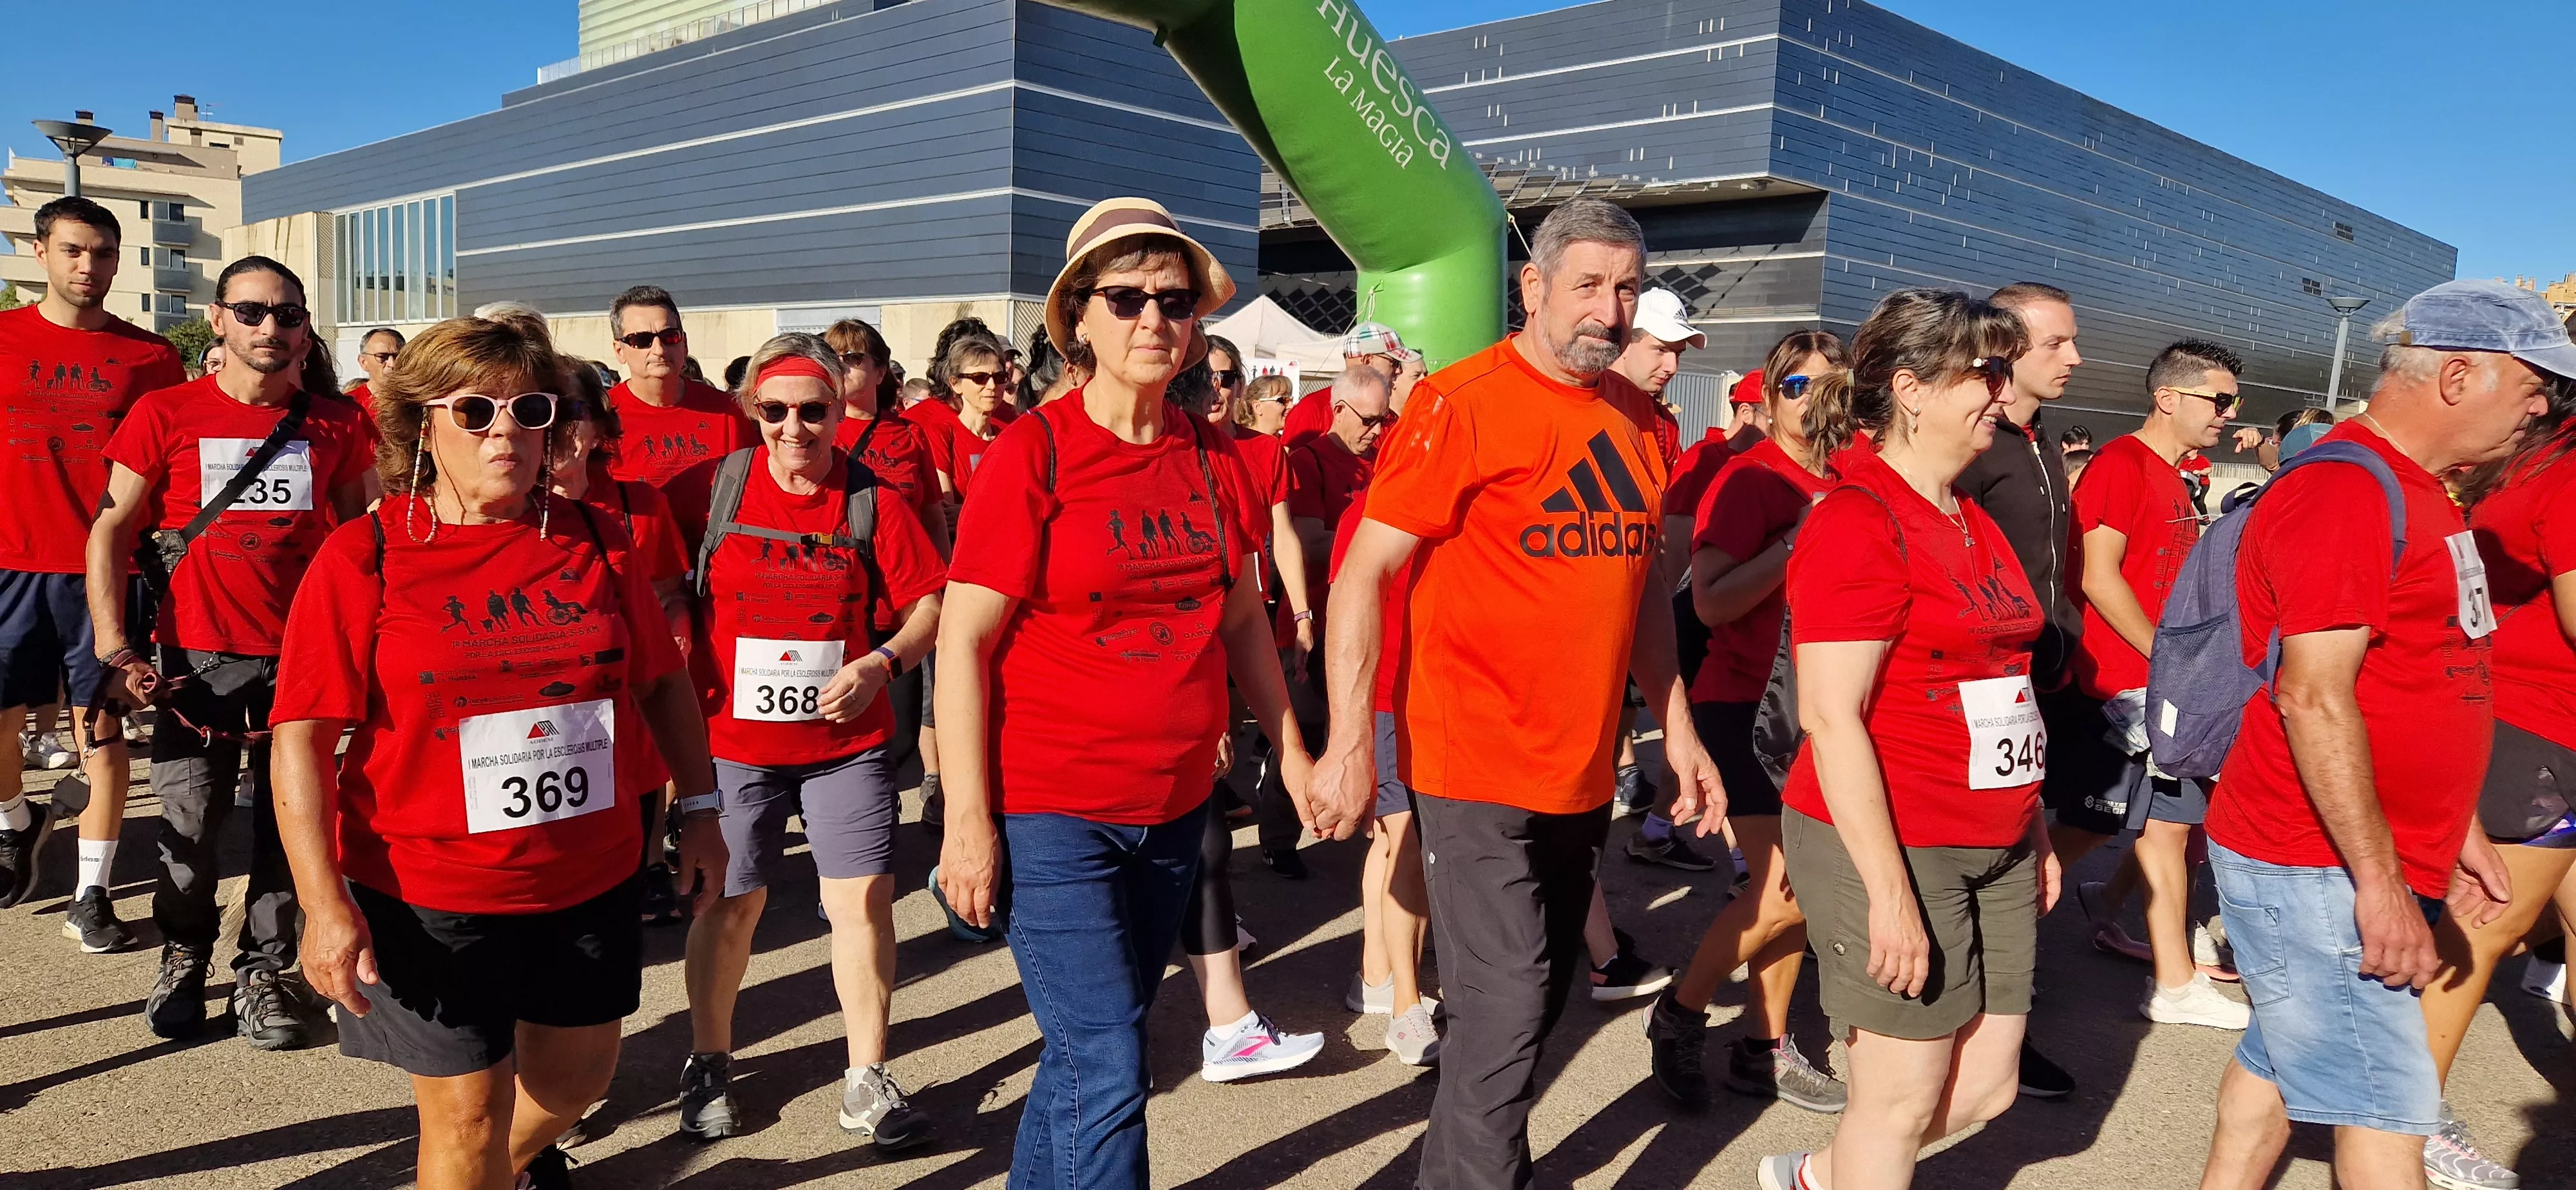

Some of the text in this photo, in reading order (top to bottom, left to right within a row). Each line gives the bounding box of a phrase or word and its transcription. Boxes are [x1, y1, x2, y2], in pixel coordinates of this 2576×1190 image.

[1519, 511, 1656, 557] adidas
[1125, 561, 1160, 571] MARCHA
[1164, 556, 1204, 568] SOLIDARIA
[462, 637, 509, 648] MARCHA
[511, 630, 567, 645] SOLIDARIA
[759, 668, 781, 677] SOLIDARIA
[797, 670, 821, 678] ESCLEROSIS
[755, 685, 820, 714] 368
[1975, 716, 1994, 729] MARCHA
[471, 756, 499, 770] MARCHA
[500, 751, 533, 766] SOLIDARIA
[533, 748, 545, 761] POR
[545, 748, 553, 759] LA
[554, 742, 585, 757] ESCLEROSIS
[1995, 730, 2045, 777] 346
[501, 766, 589, 818] 369
